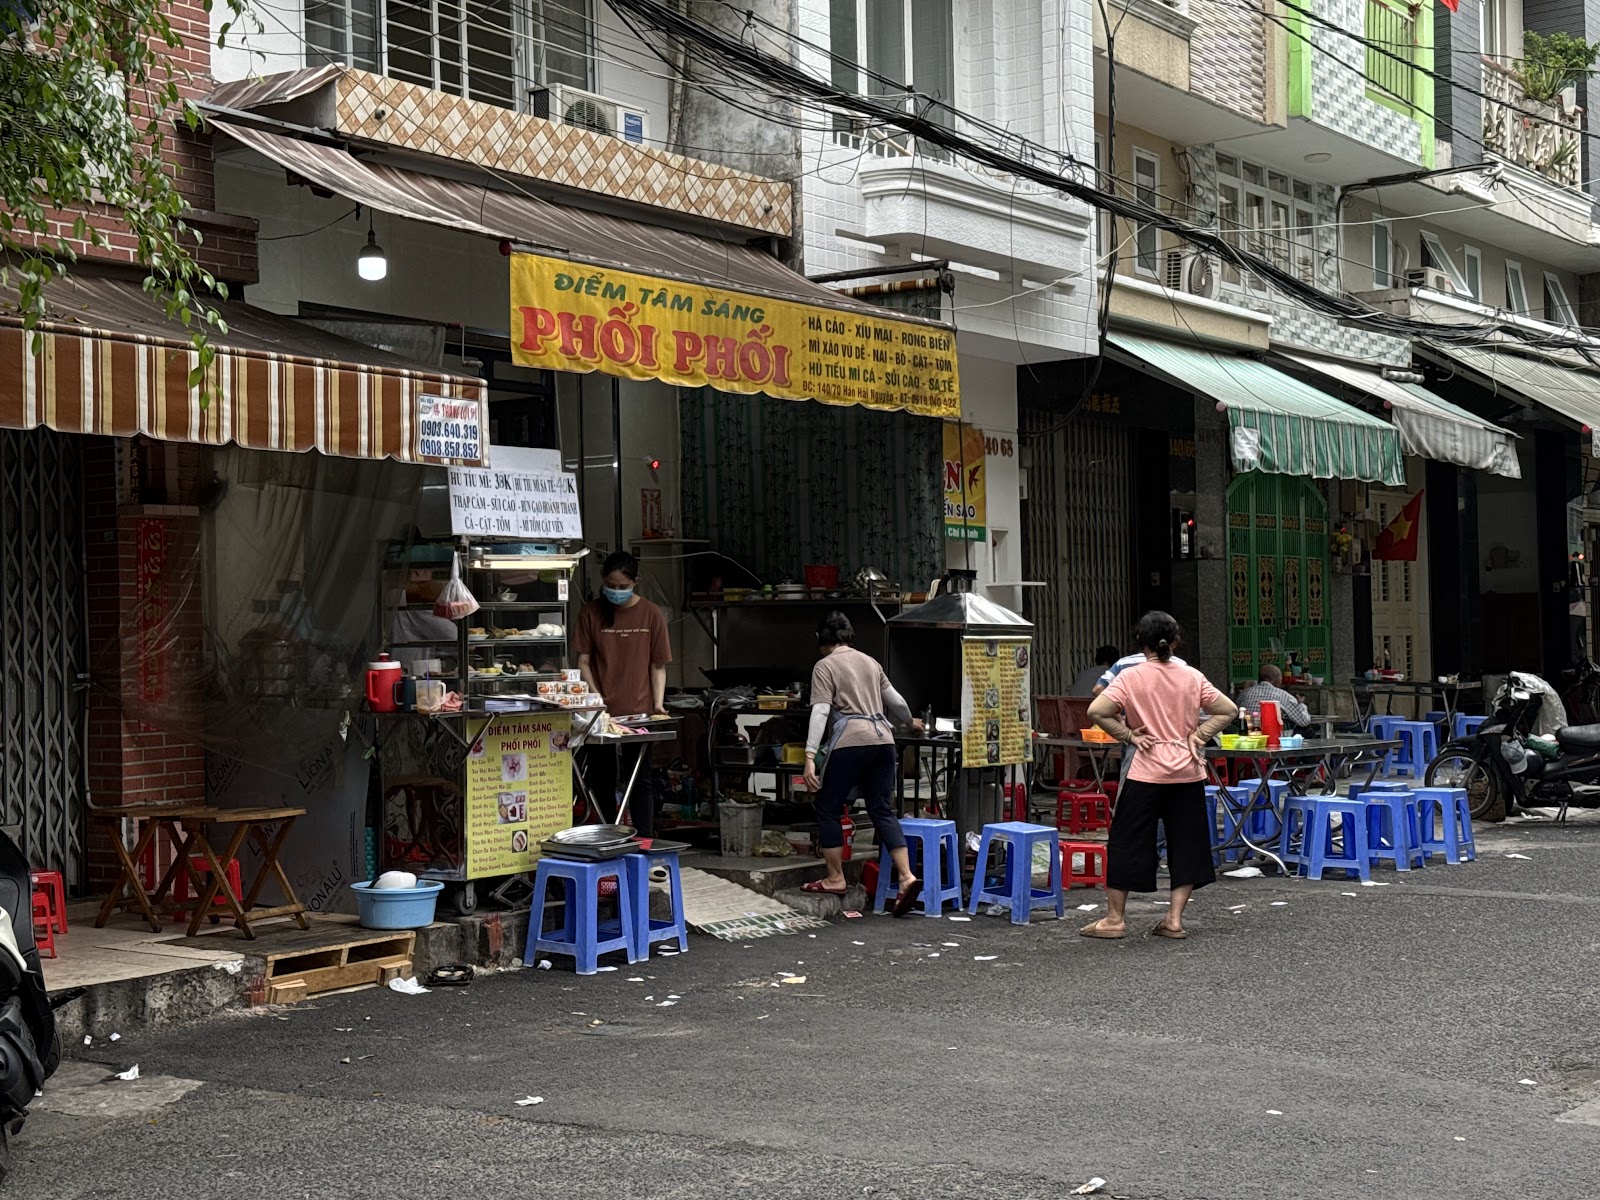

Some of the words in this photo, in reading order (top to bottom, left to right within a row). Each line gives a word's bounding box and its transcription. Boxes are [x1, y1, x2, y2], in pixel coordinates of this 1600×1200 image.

[554, 272, 626, 300] ĐIỂM
[638, 287, 693, 312] TÂM
[700, 298, 765, 323] SÁNG
[808, 316, 822, 332] HÁ
[825, 316, 845, 335] CẢO
[855, 322, 871, 339] XÍU
[874, 327, 892, 345] MẠI
[901, 332, 926, 347] RONG
[518, 302, 660, 371] PHỐI
[672, 324, 790, 387] PHỐI
[808, 337, 820, 353] MÌ
[822, 339, 839, 356] XÀO
[855, 343, 866, 360] DÊ
[873, 349, 887, 364] NAI
[808, 359, 822, 376] HỦ
[825, 361, 846, 380] TIẾU
[849, 366, 860, 381] MÌ
[863, 367, 876, 383] CÁ
[817, 382, 841, 396] 140/70
[421, 420, 478, 440] 0903.640.319
[420, 439, 479, 458] 0908.858.852
[1001, 438, 1014, 458] 68
[494, 473, 512, 490] 38K
[464, 513, 474, 530] CÁ
[488, 721, 510, 736] ĐIỂM
[512, 722, 530, 734] TÂM
[531, 720, 552, 733] SÁNG
[501, 739, 521, 751] PHỐI
[523, 736, 541, 750] PHỐI
